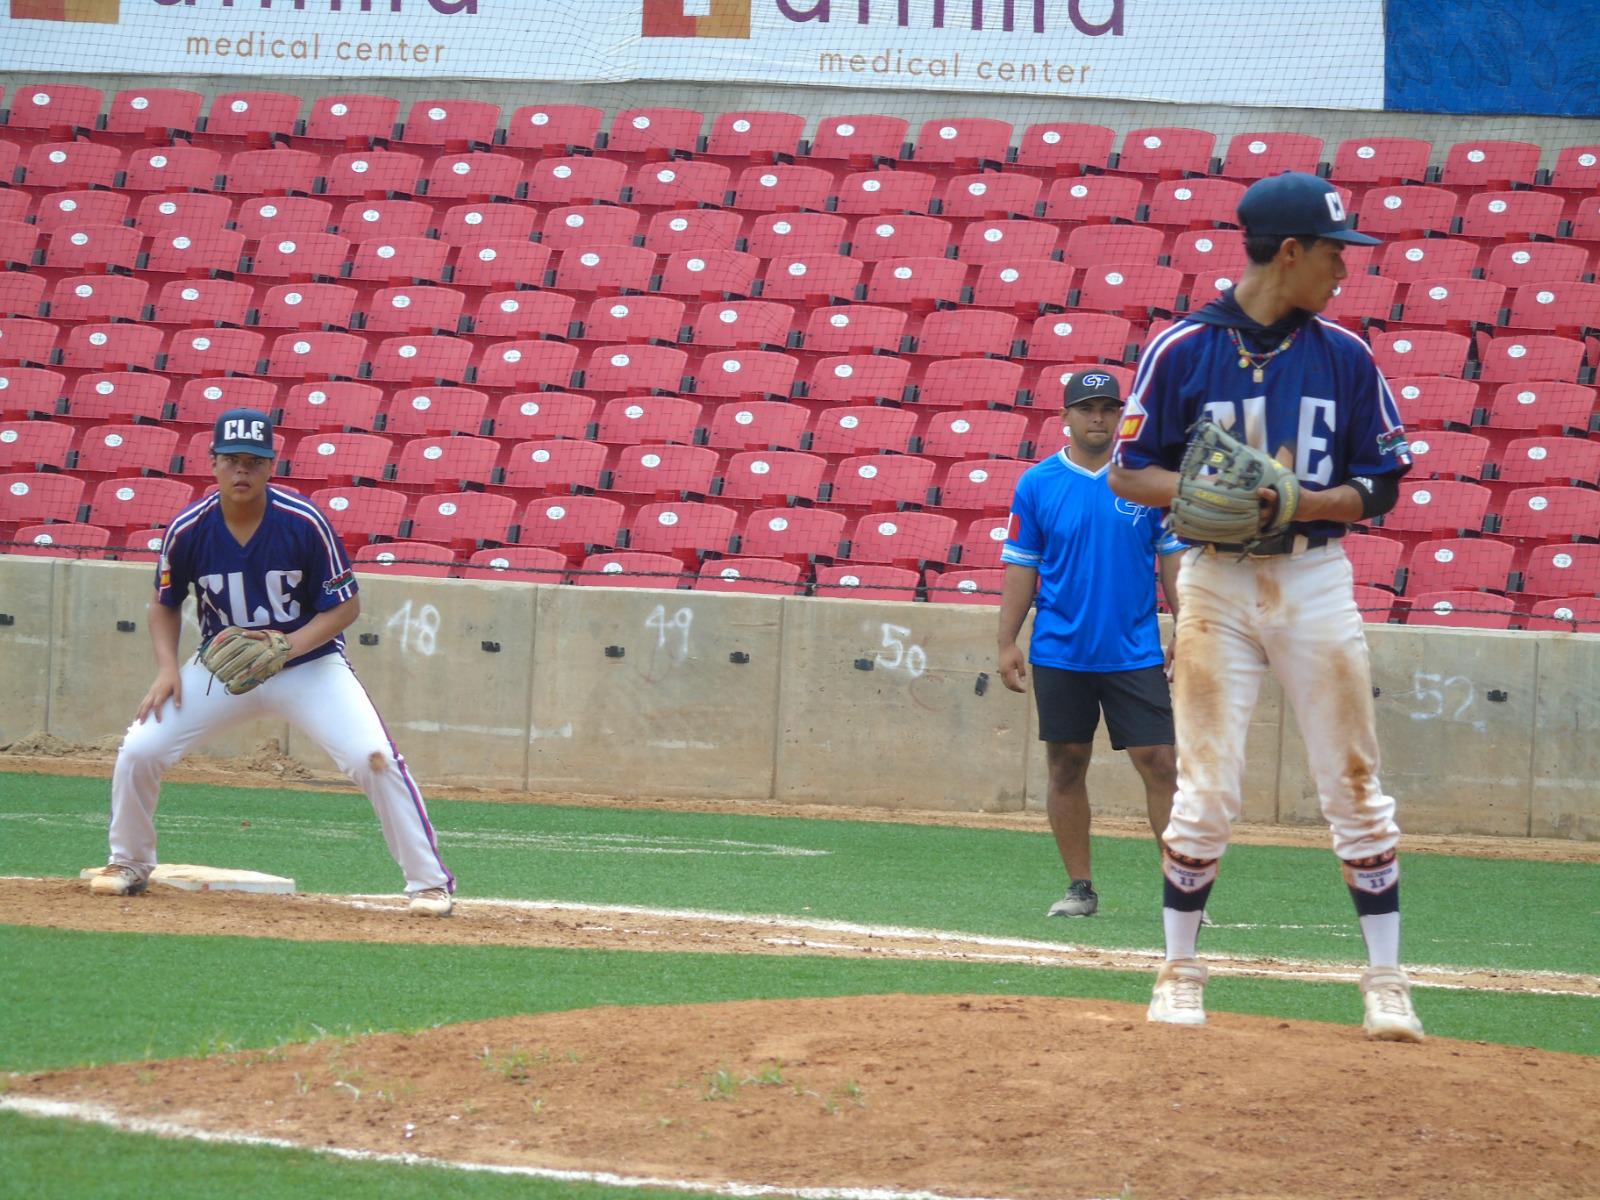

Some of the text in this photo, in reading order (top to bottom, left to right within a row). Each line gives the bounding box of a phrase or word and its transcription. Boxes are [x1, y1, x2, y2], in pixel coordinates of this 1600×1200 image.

[186, 31, 446, 63] medical center
[819, 49, 1091, 84] medical center
[223, 419, 264, 441] CLE
[198, 570, 303, 628] CLE
[387, 599, 441, 656] 48
[644, 604, 694, 659] 49
[876, 623, 927, 677] 50
[1410, 671, 1488, 733] 52
